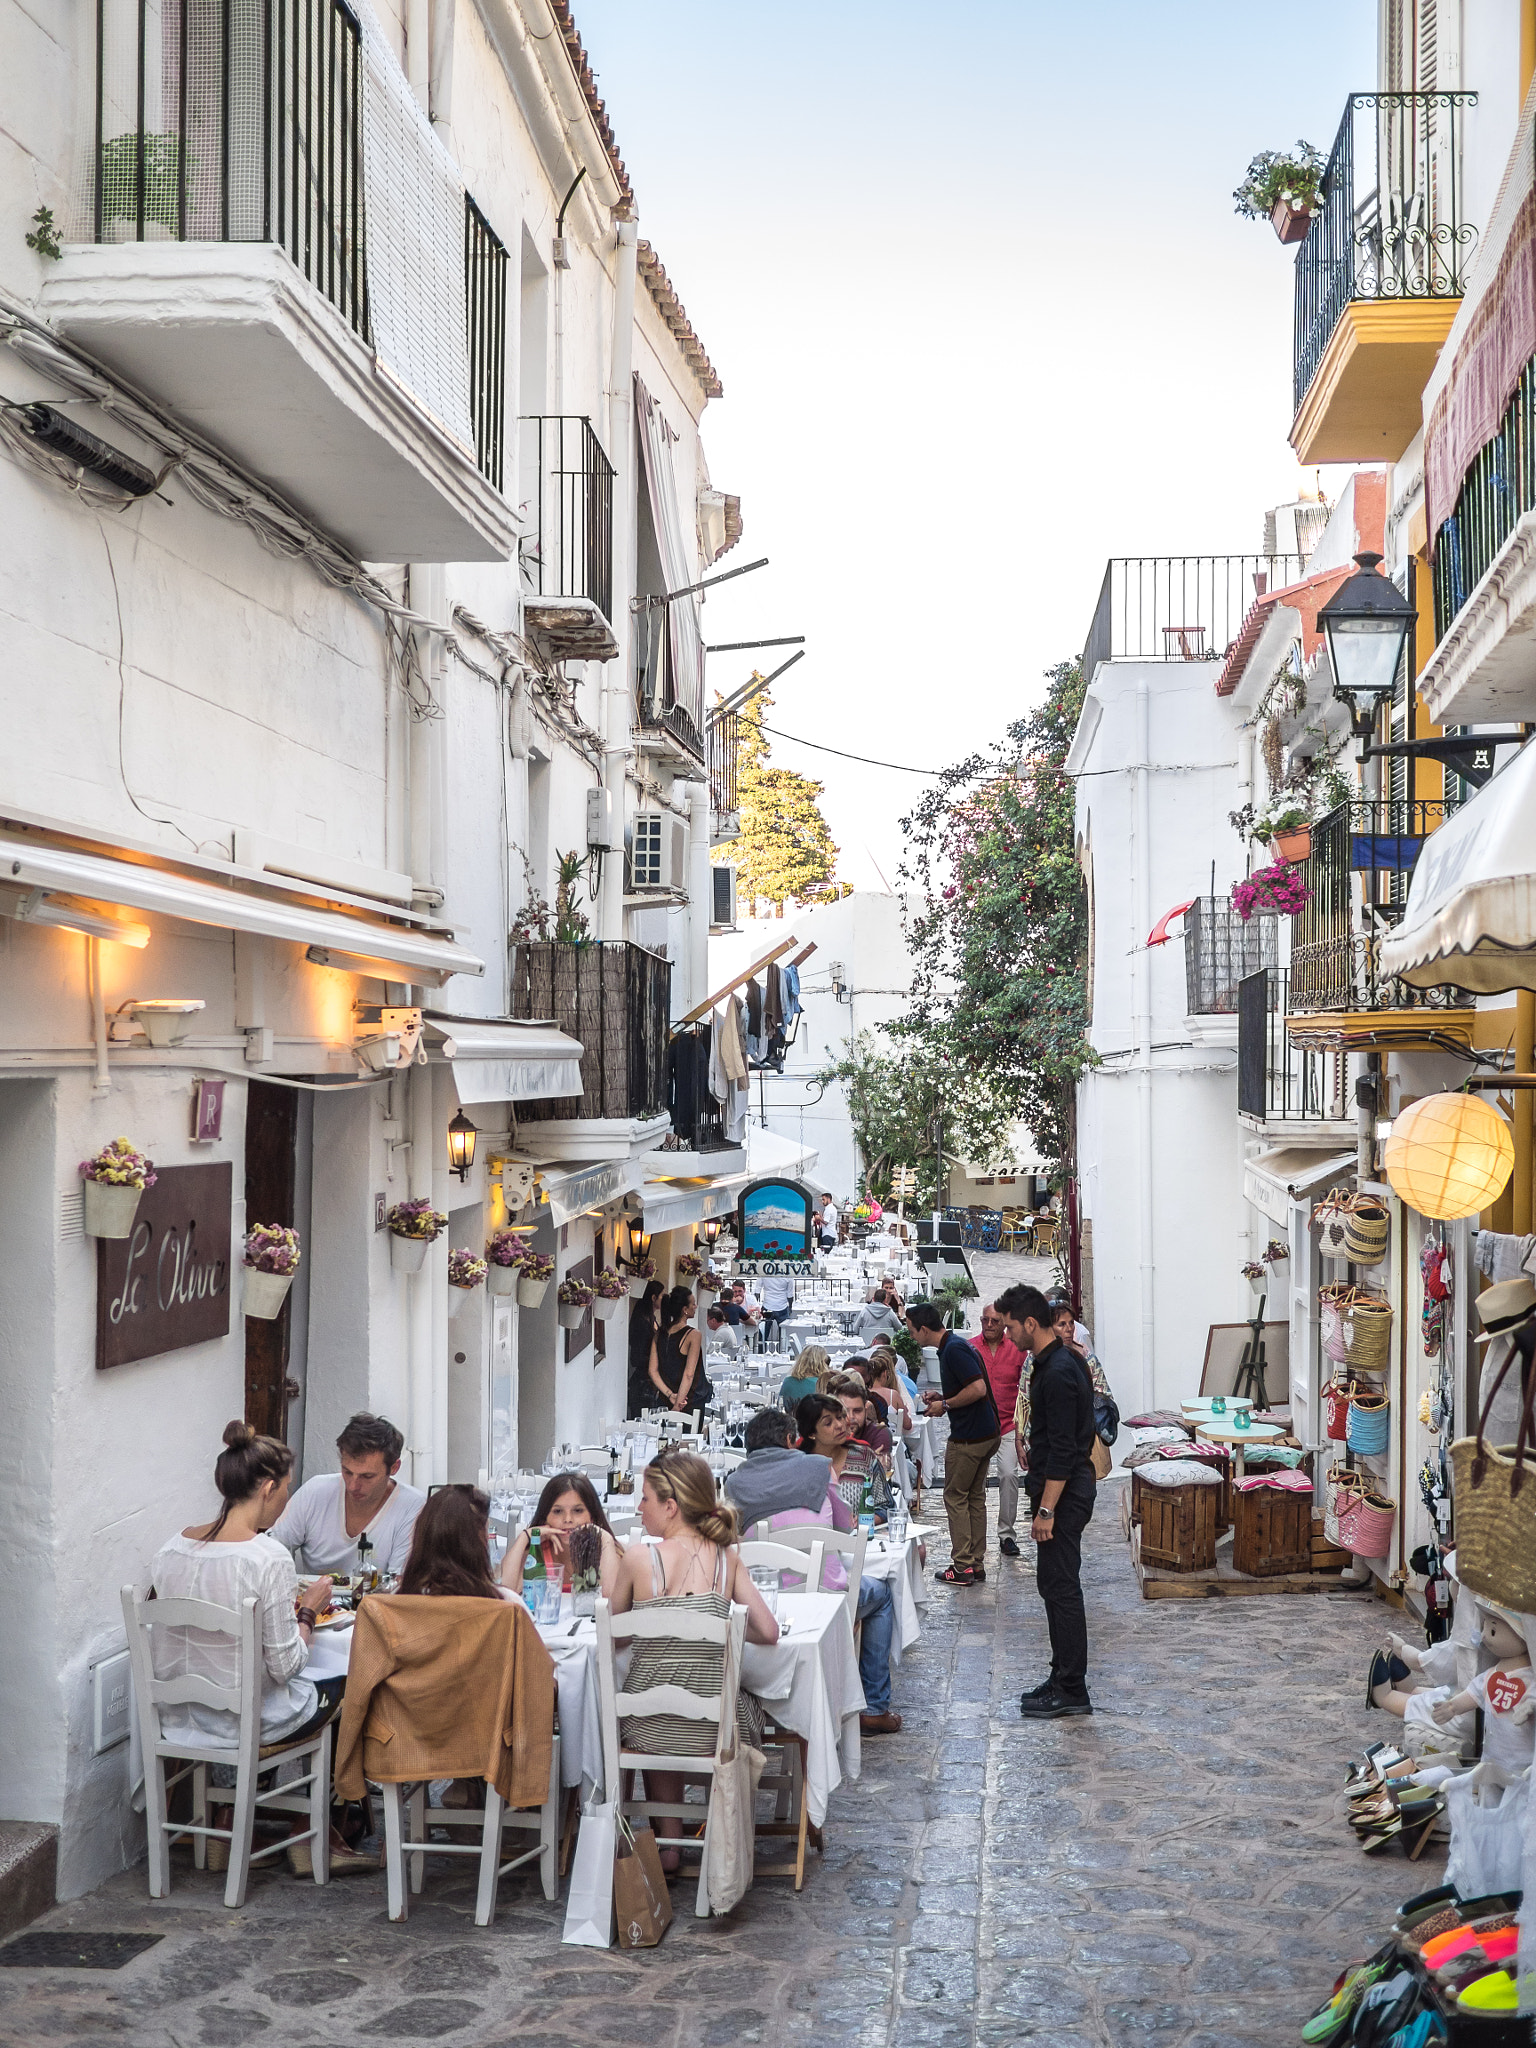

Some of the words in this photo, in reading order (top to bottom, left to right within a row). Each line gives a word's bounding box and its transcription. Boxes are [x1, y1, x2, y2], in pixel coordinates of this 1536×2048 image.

[377, 1200, 384, 1223] 6
[739, 1262, 759, 1275] LA
[763, 1262, 812, 1276] OLIVA
[945, 1571, 955, 1580] N
